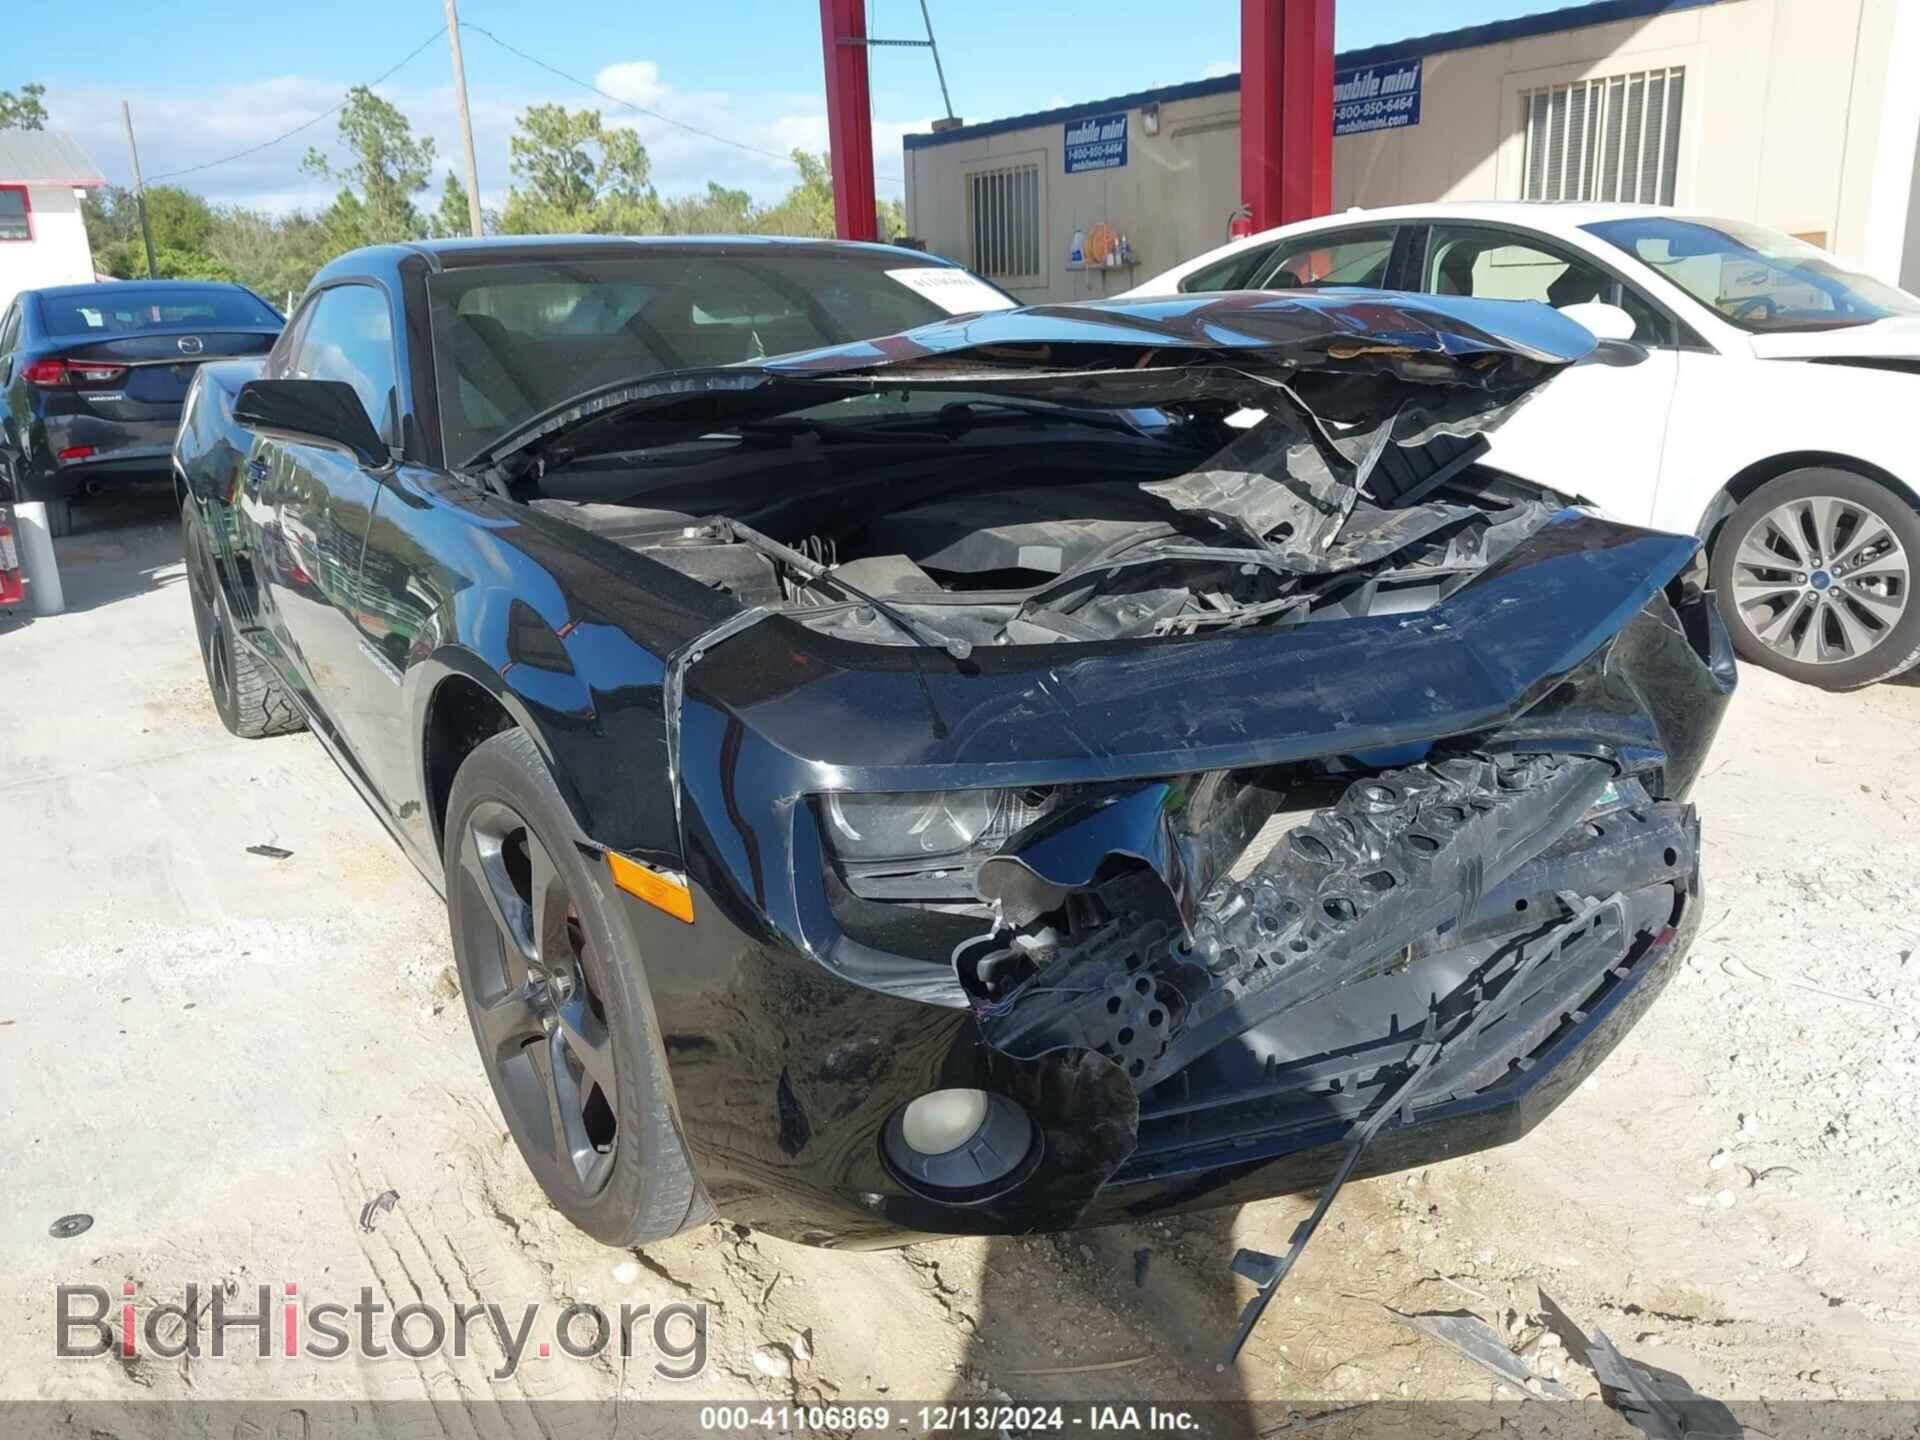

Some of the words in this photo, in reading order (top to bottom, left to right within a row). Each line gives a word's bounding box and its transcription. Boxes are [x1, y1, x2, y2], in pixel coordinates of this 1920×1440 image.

[1333, 70, 1380, 101] mobile
[1381, 65, 1419, 93] mini
[1332, 96, 1413, 120] 1-800-950-6464
[1067, 120, 1100, 145] mobile
[1101, 118, 1125, 140] mini
[1336, 115, 1408, 133] mobilemini.com
